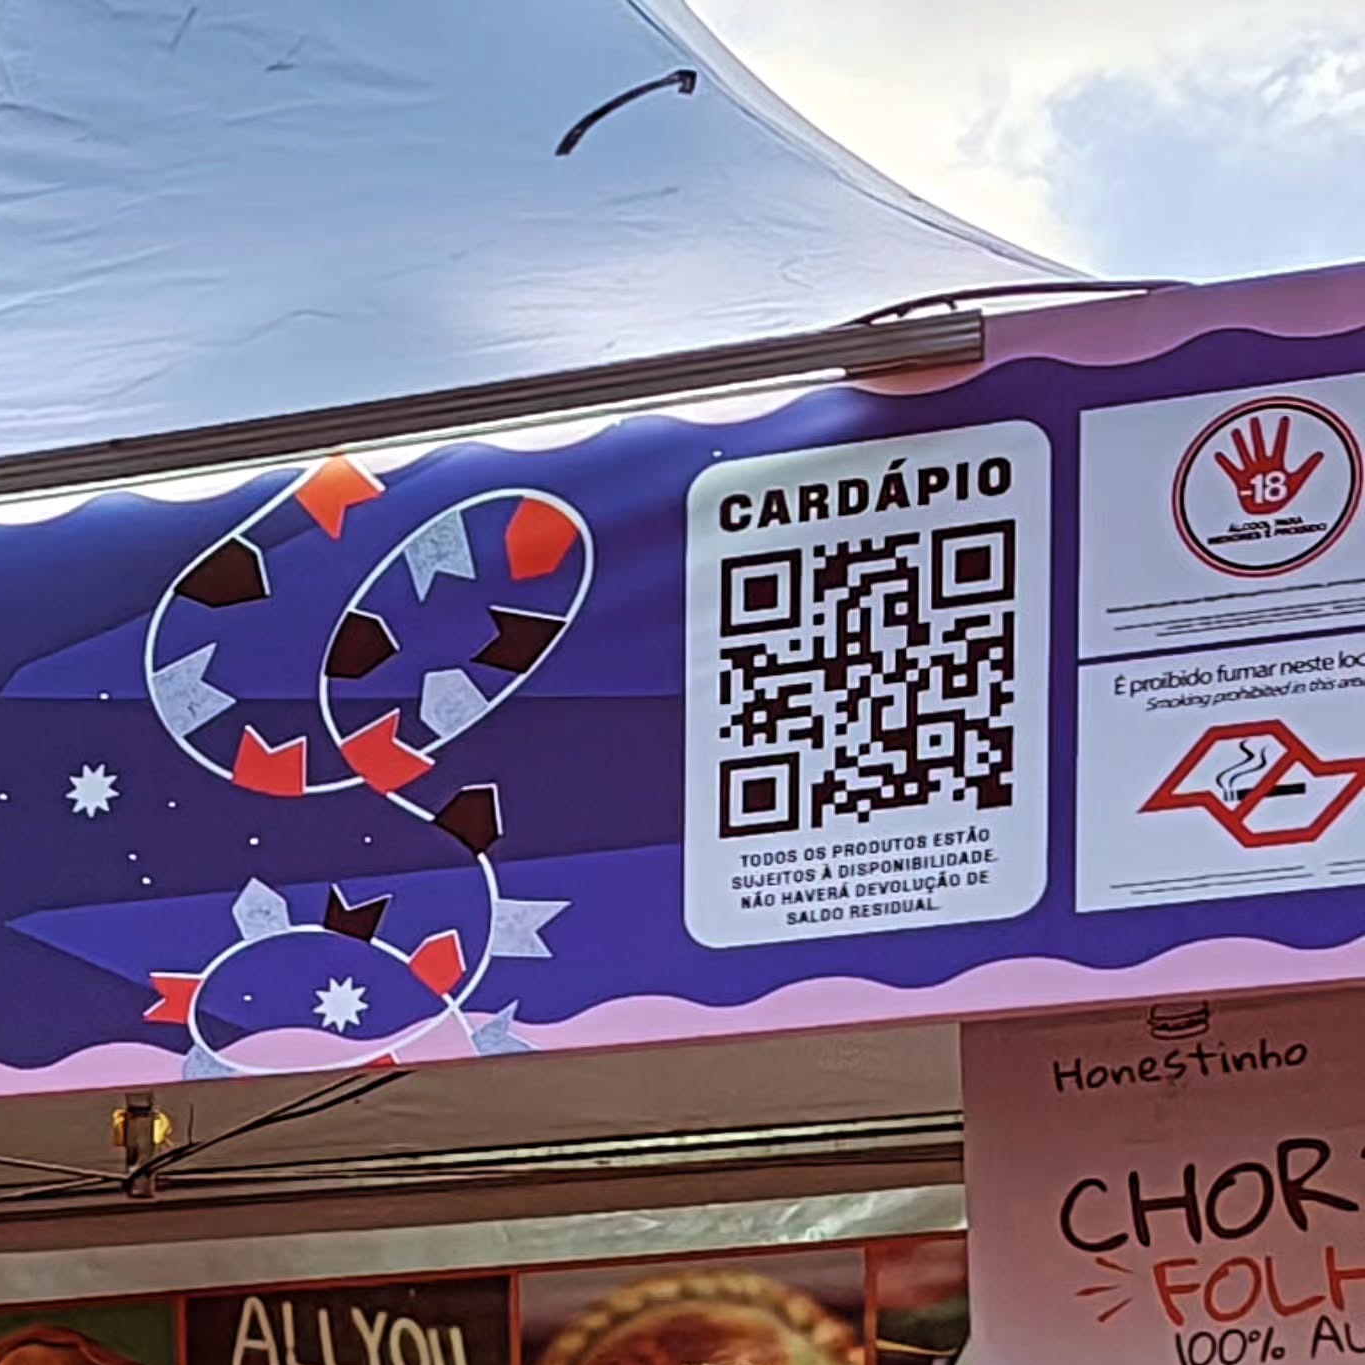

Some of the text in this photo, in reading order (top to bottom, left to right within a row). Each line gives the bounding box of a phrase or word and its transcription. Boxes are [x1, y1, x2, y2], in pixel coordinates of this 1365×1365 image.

[719, 456, 1012, 533] CARDÁPIO
[1114, 674, 1127, 696] É
[1130, 667, 1213, 698] proibido
[1217, 661, 1277, 683] fumar
[1280, 655, 1334, 676] neste
[740, 825, 991, 868] TODOS OS PRODUTOS ESTÃO
[731, 868, 817, 890] SUJEITOS
[740, 870, 990, 910] NÃO HAVERÁ DEVOLUÇÃO DE
[786, 907, 844, 926] SALDO
[1052, 1038, 1310, 1094] Honestinho
[1059, 1137, 1365, 1253] CHOR
